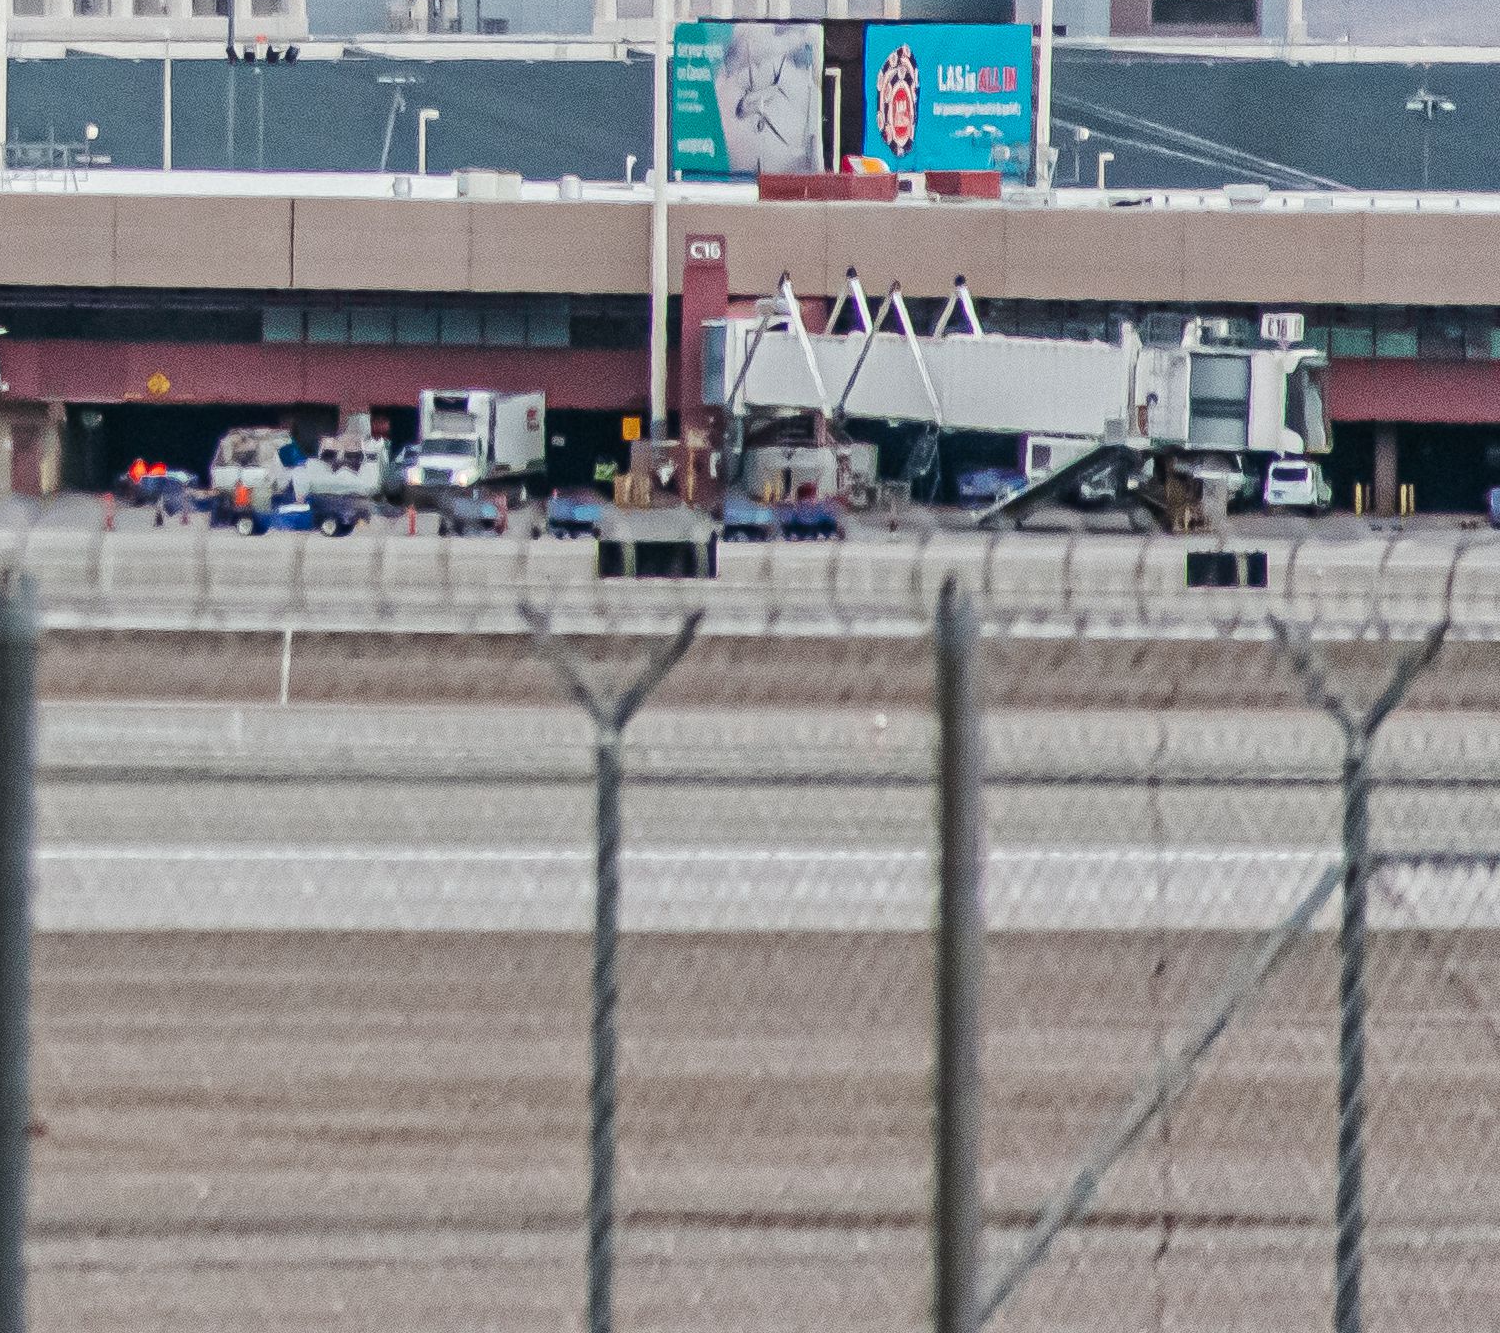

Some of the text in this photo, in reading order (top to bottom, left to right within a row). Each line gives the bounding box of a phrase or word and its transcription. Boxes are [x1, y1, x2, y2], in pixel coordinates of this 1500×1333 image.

[937, 64, 964, 92] LAS
[978, 66, 1001, 93] ALL
[1002, 66, 1017, 92] IN
